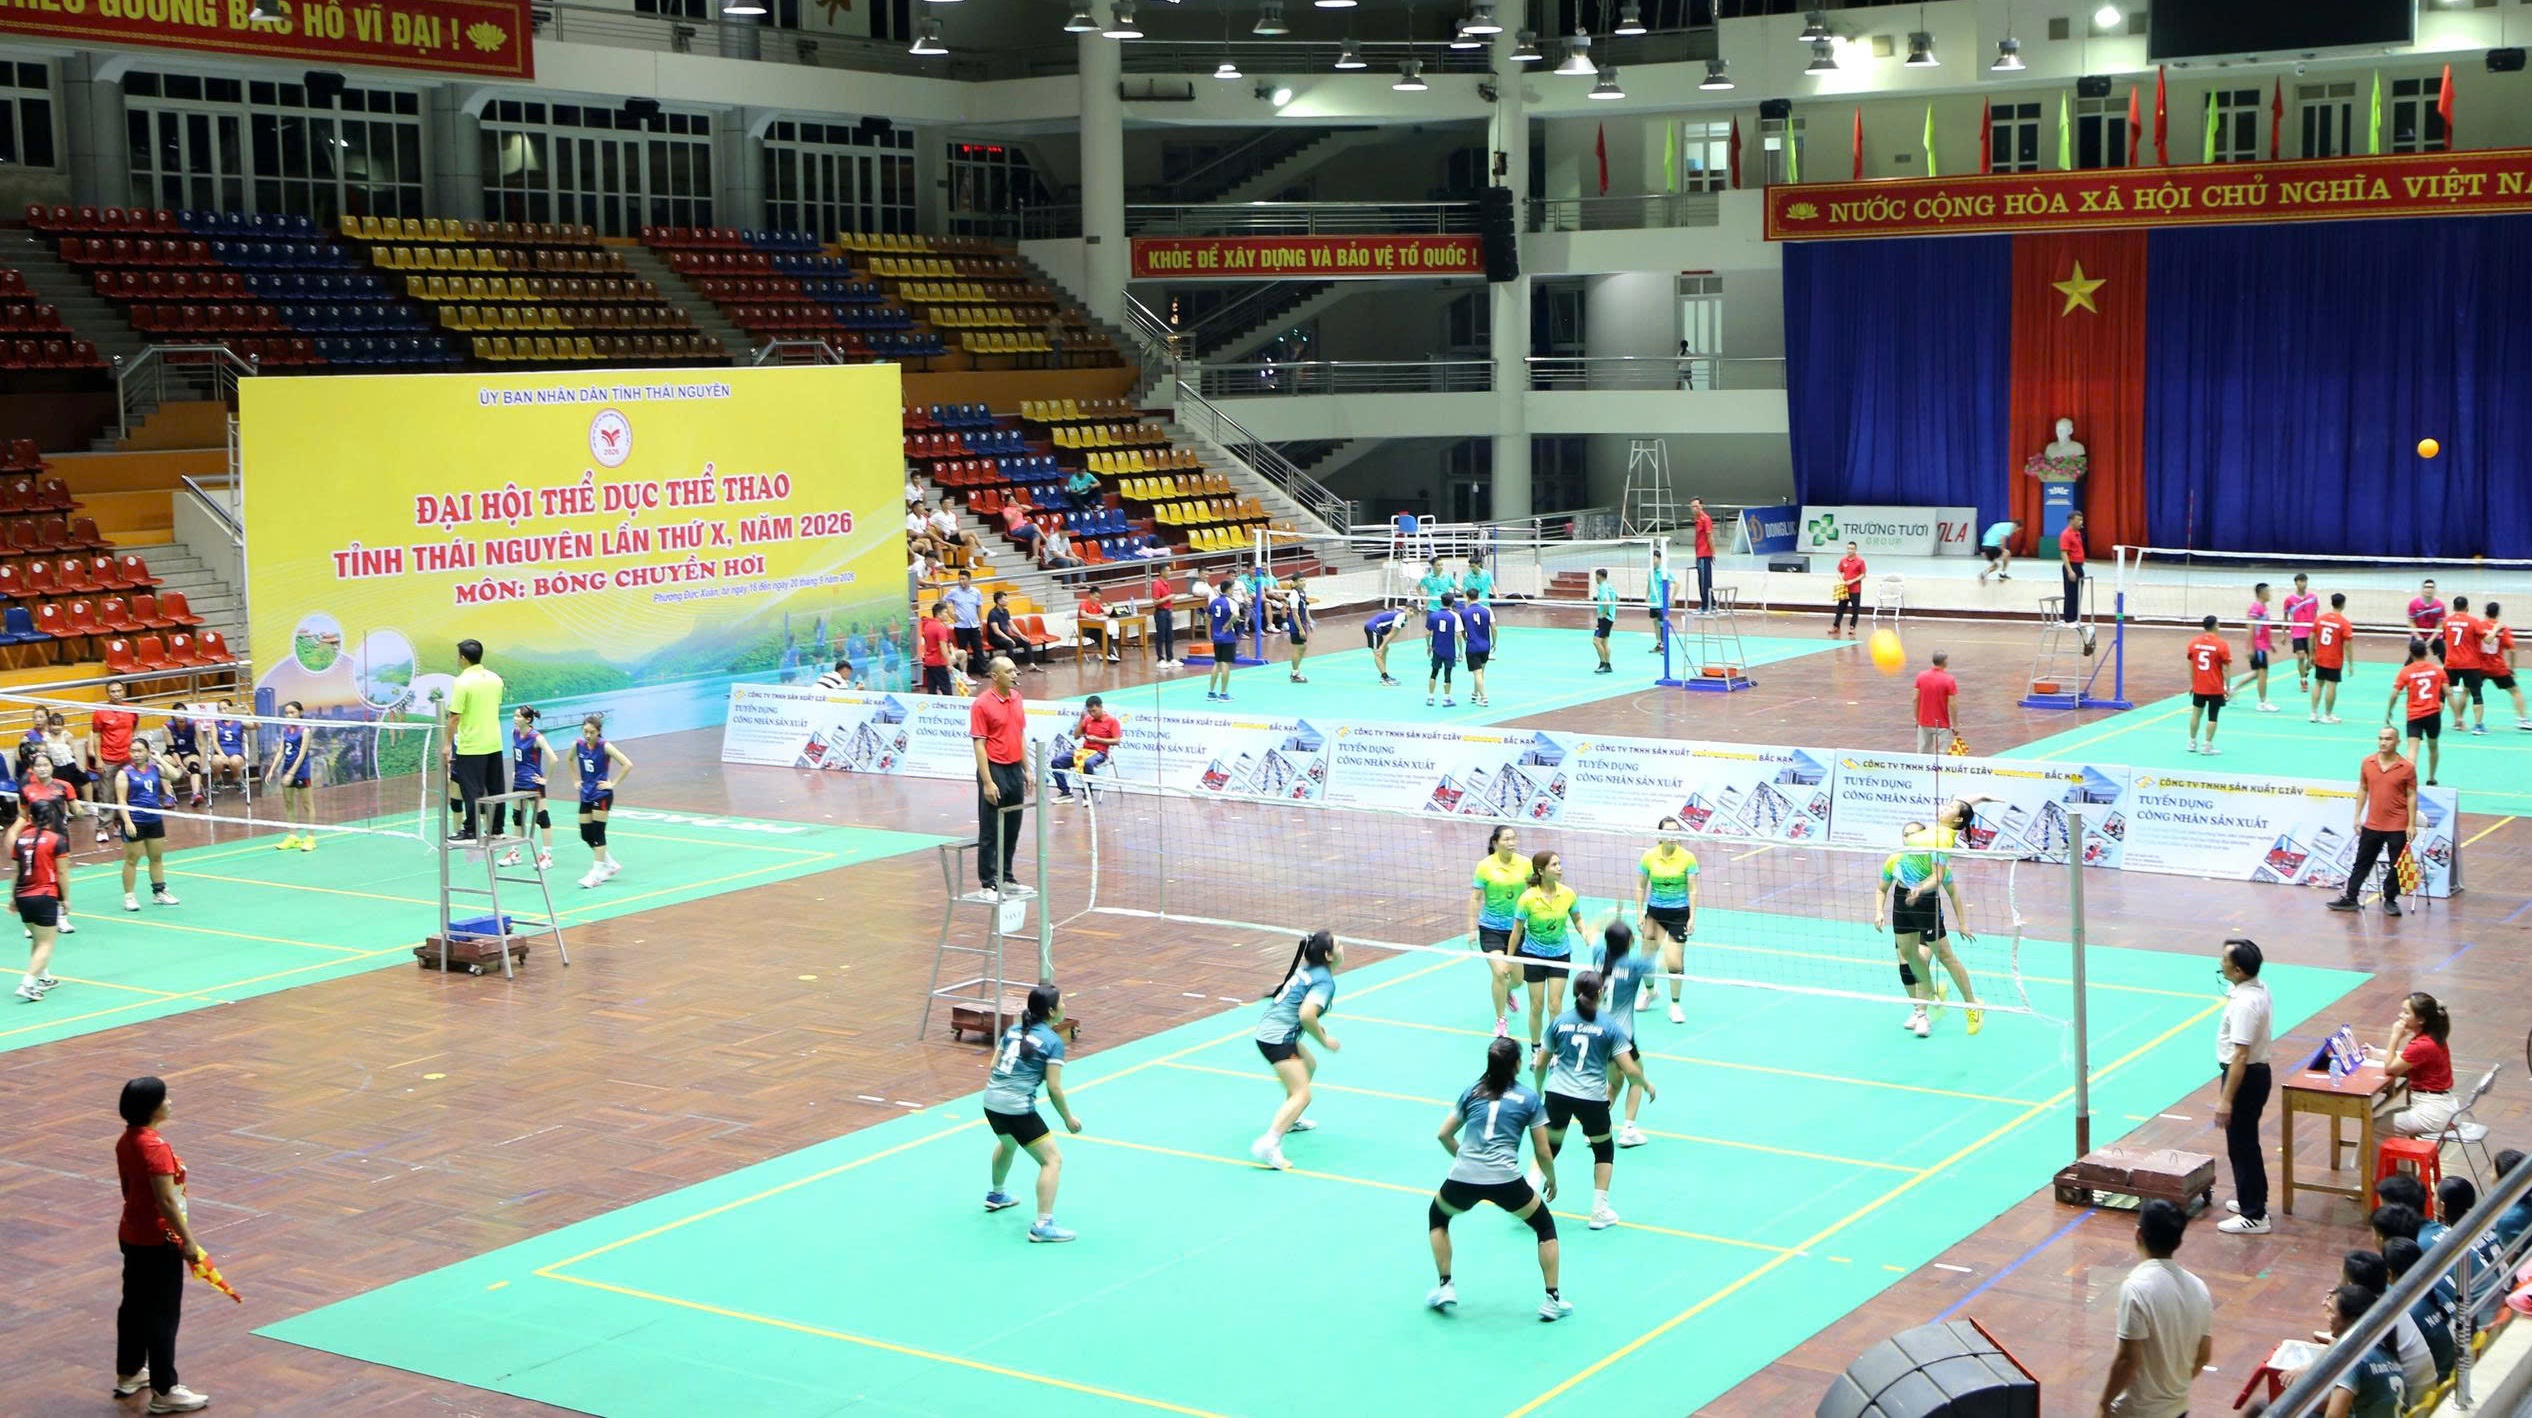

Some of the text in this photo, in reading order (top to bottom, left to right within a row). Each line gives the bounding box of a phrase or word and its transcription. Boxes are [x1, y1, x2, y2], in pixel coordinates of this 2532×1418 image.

[303, 0, 345, 39] HỒ
[356, 7, 384, 43] VĨ
[391, 13, 442, 55] ĐẠI
[452, 19, 460, 49] !
[1829, 194, 1906, 223] NƯỚC
[1914, 191, 1995, 223] CỘNG
[2004, 187, 2069, 215] HÒA
[2079, 185, 2124, 211] XÃ
[2134, 181, 2191, 214] HỘI
[2201, 175, 2267, 206] CHỦ
[2279, 175, 2390, 203] NGHĨA
[2403, 167, 2486, 203] VIỆT
[1149, 242, 1192, 269] KHỎE
[1198, 242, 1219, 268] ĐỂ
[1224, 246, 1254, 268] XÂY
[1261, 247, 1306, 272] DỰNG
[1311, 245, 1332, 267] VÀ
[1337, 241, 1368, 267] BẢO
[1374, 245, 1394, 271] VỆ
[1399, 241, 1419, 266] TỔ
[1423, 241, 1466, 266] QUỐC
[481, 383, 730, 405] ỦY BAN NHÂN DÂN TỈNH THÁI NGUYÊN
[417, 464, 790, 530] ĐẠI HỘI THỂ DỤC THỂ THAO
[1843, 522, 1928, 536] TRƯỜNG TƯƠI
[334, 512, 852, 578] TỈNH THÁI NGUYÊN LẦN THỨ X, NĂM 2026
[456, 555, 765, 604] MÔN: BÓNG CHUYỀN HƠI
[1215, 606, 1221, 618] 3
[1472, 613, 1480, 626] 4
[2321, 627, 2333, 645] 6
[2451, 627, 2463, 646] 7
[2198, 651, 2209, 671] 5
[2417, 678, 2432, 699] 2
[225, 730, 233, 742] 5
[285, 743, 293, 755] 2
[584, 759, 594, 773] 16
[1578, 759, 1639, 772] TUYỂN DỤNG
[1863, 758, 1886, 769] CÔNG
[144, 781, 154, 793] 4
[1576, 773, 1683, 789] CÔNG NHÂN SẢN XUẤT
[1844, 776, 1912, 791] TUYỂN DỤNG
[2159, 777, 2185, 789] CÔNG
[2187, 779, 2199, 789] TY
[2201, 781, 2227, 791] TNHH
[2229, 780, 2248, 793] SẢN
[2251, 781, 2278, 795] XUẤT
[2279, 784, 2304, 796] GIẤY
[1842, 790, 1873, 802] CÔNG
[1875, 792, 1907, 804] NHÂN
[1909, 792, 1930, 806] SẢN
[2139, 794, 2214, 812] TUYỂN DỤNG
[2137, 809, 2269, 830] CÔNG NHÂN SẢN XUẤT
[1571, 1034, 1589, 1072] 7
[1484, 1100, 1501, 1140] 1
